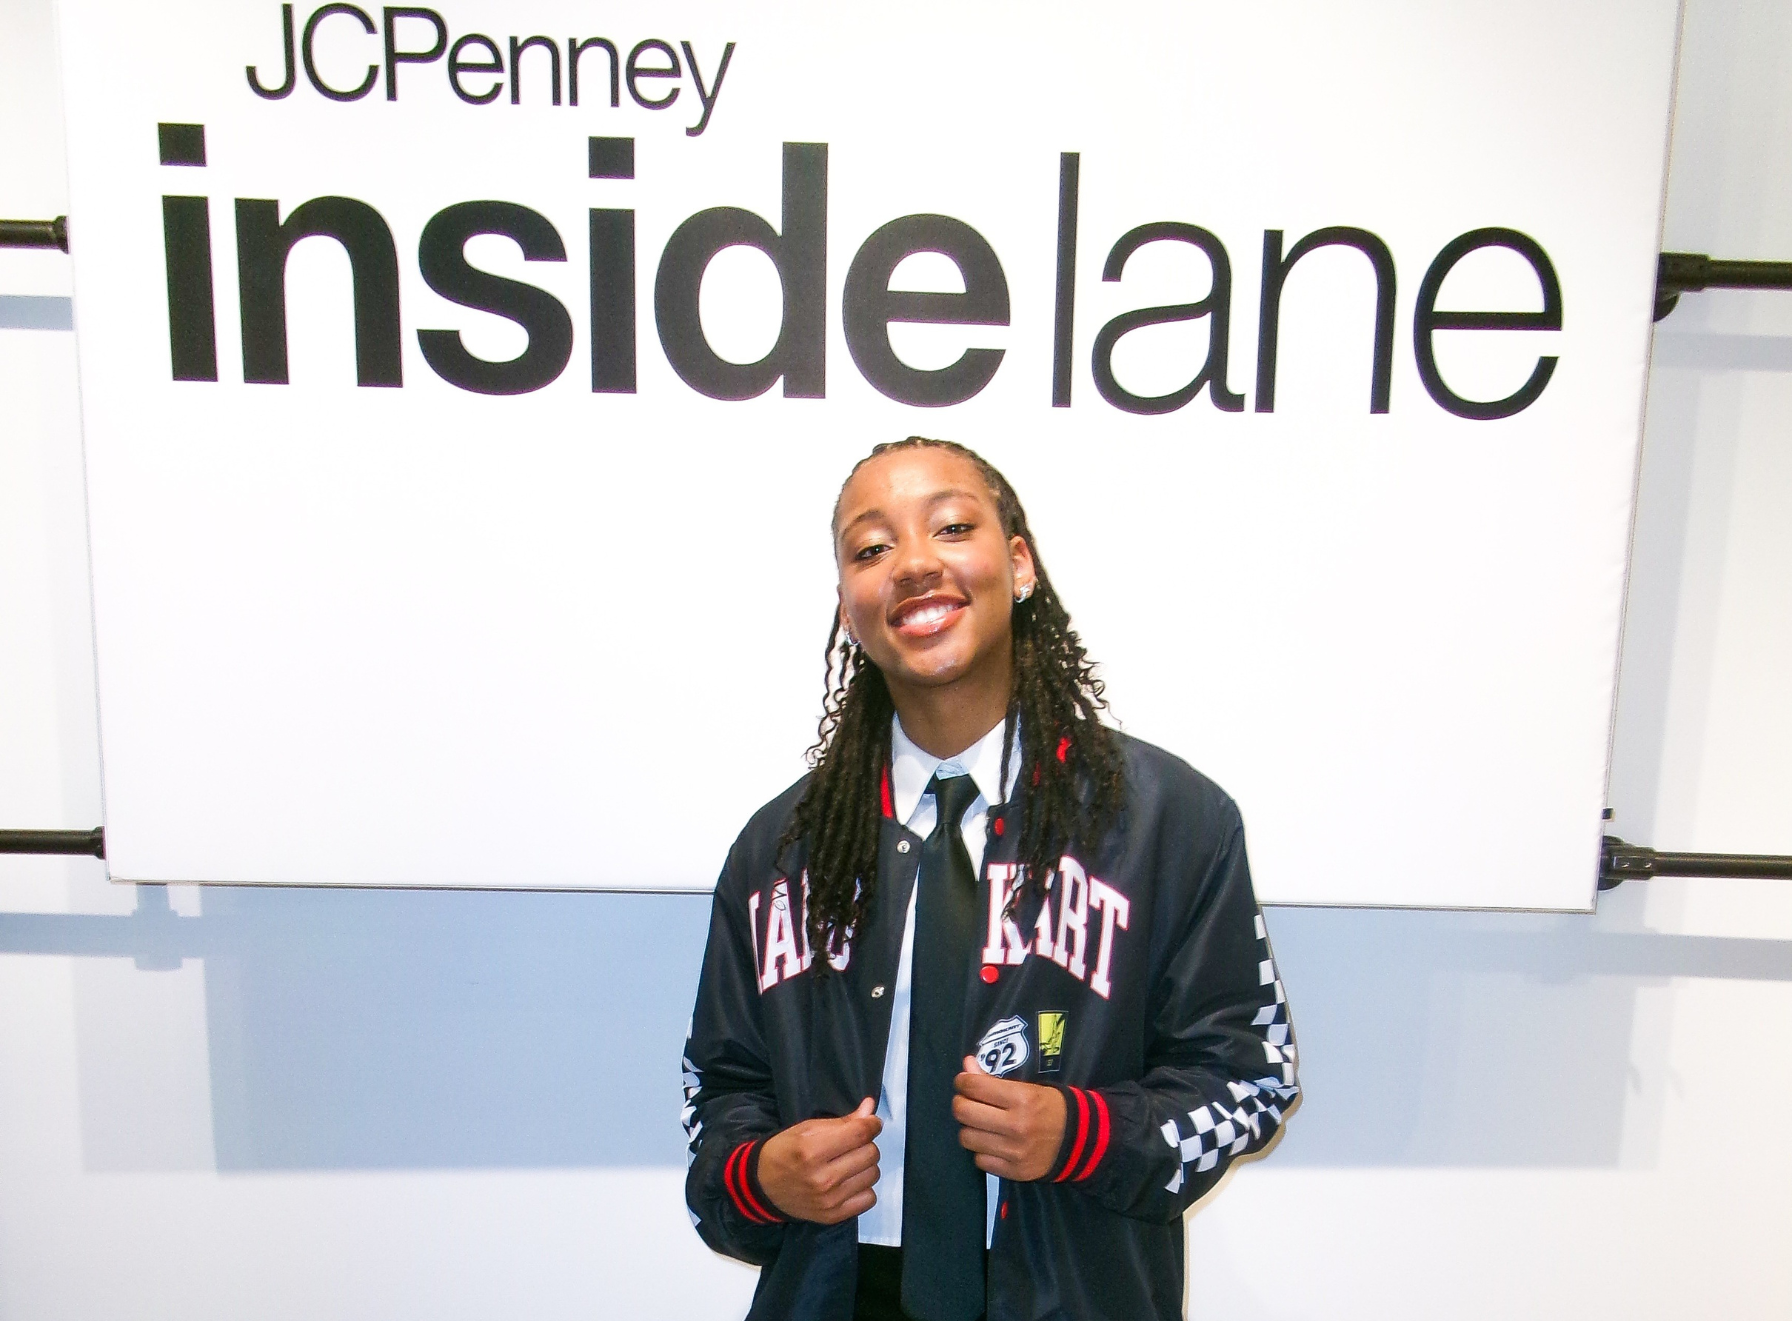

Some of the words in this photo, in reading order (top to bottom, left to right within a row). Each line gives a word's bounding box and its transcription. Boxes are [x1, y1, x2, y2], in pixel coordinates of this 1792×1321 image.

[246, 3, 736, 137] JCPenney
[158, 123, 1011, 408] inside
[1053, 152, 1563, 421] lane
